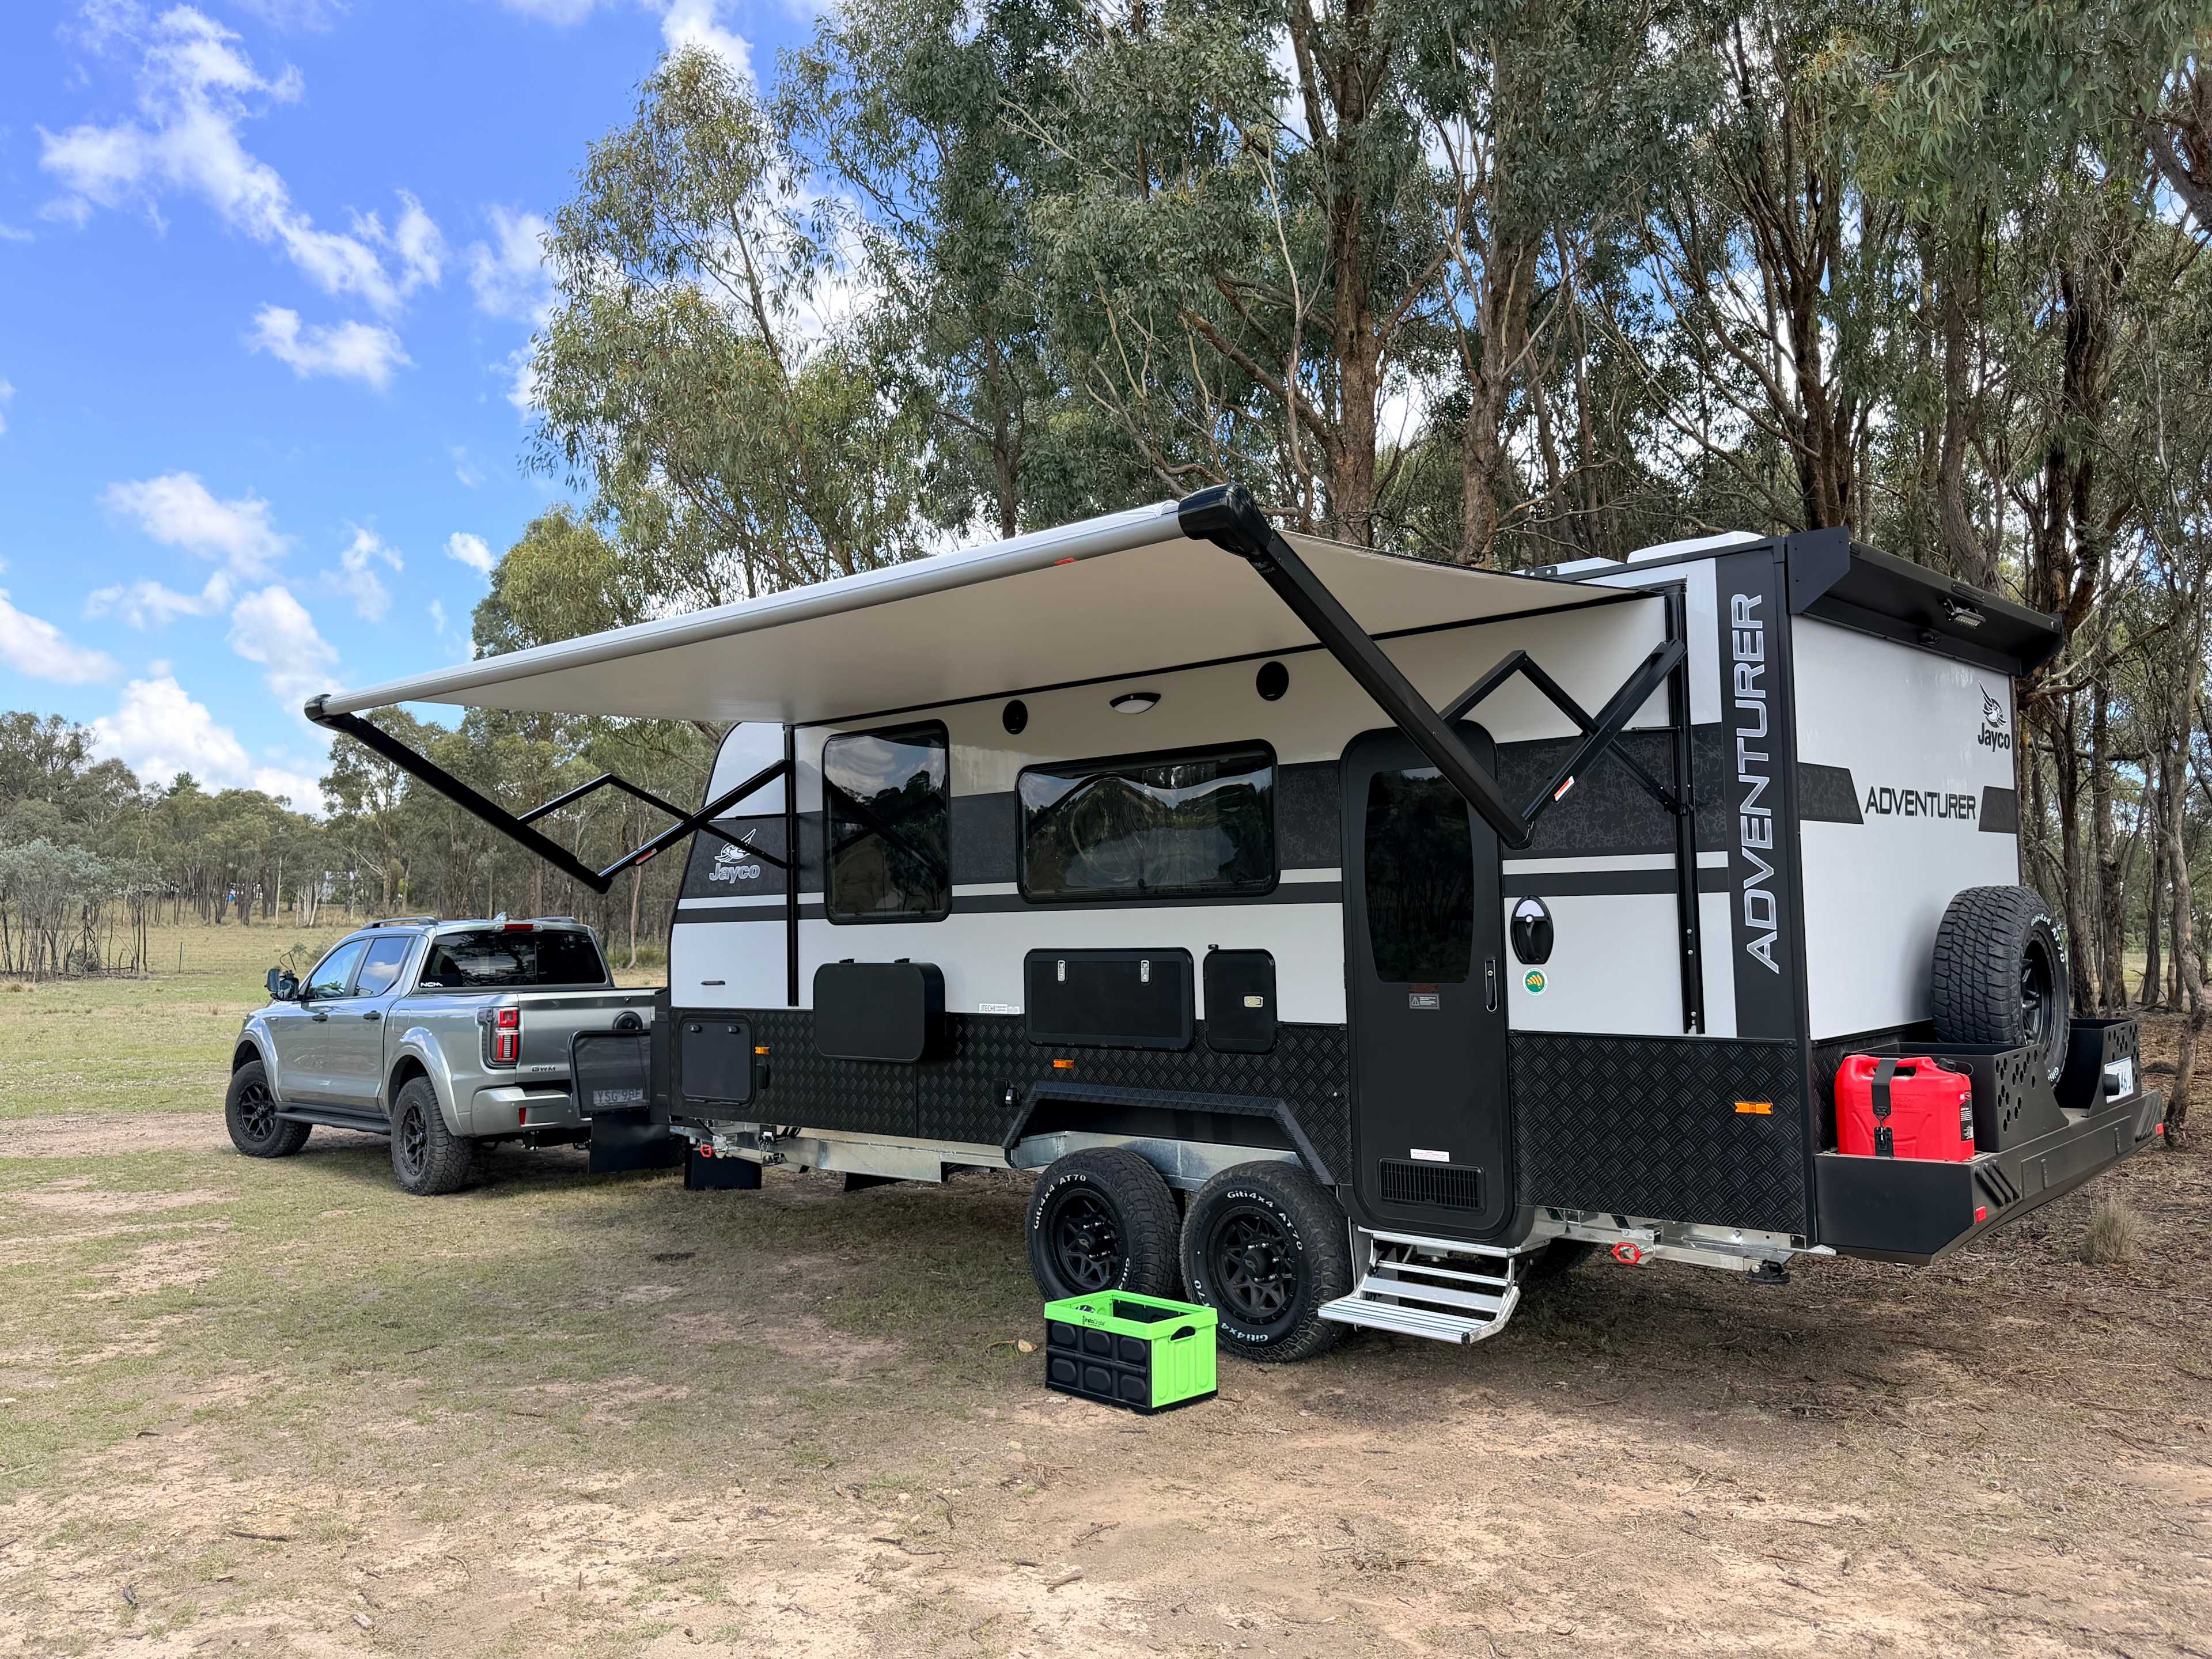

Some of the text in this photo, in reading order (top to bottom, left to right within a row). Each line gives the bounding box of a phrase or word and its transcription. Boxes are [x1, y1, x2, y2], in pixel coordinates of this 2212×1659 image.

[1978, 722, 2010, 752] Jayco
[1731, 594, 1779, 974] ADVENTURER
[1865, 786, 1976, 820] ADVENTURER
[709, 863, 760, 884] Jayco
[2051, 927, 2065, 963] AT70
[1033, 1175, 1086, 1229] Giti4x4 AT70
[1227, 1190, 1303, 1251] Giti4x4 AT70
[1221, 1323, 1268, 1342] Giti4x4
